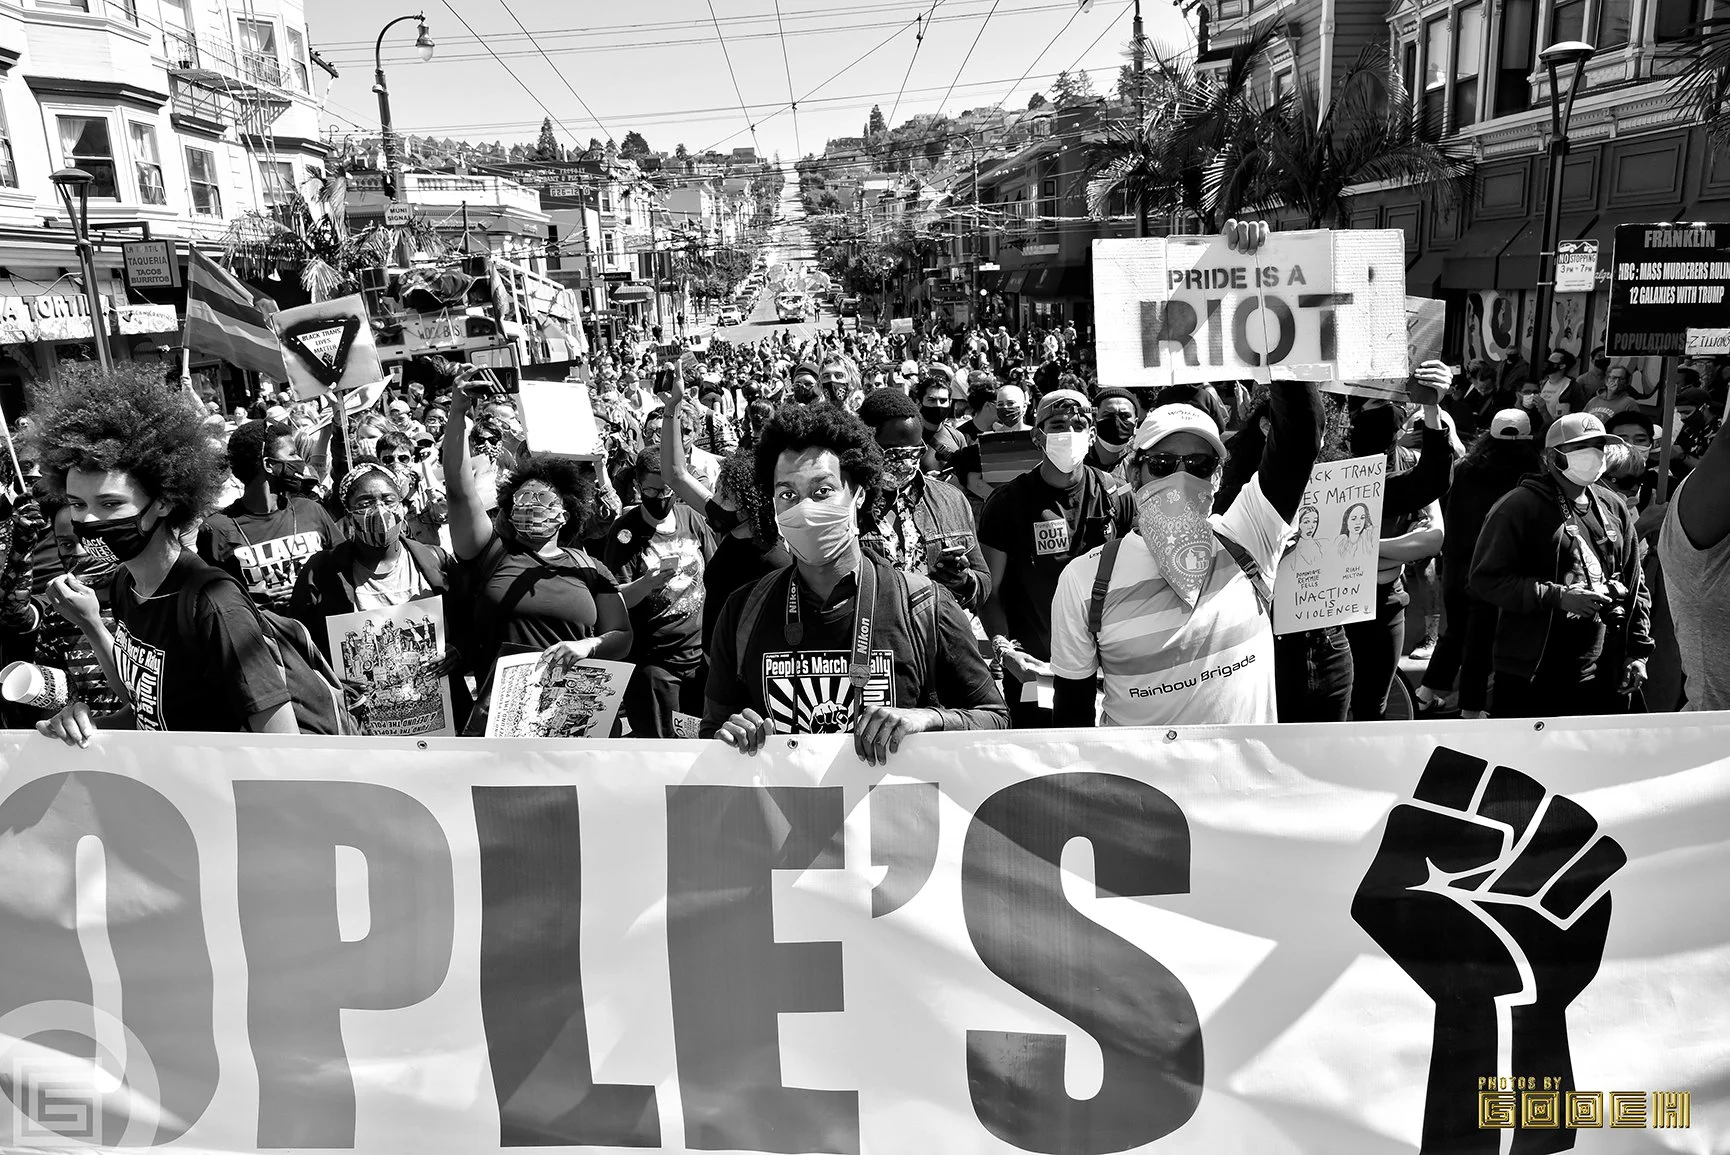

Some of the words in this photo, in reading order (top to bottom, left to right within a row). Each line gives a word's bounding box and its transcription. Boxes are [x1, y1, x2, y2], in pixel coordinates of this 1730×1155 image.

[551, 188, 591, 197] 626-120
[1644, 230, 1716, 248] FRANKLIN
[128, 257, 168, 266] TAQUERIA
[1559, 253, 1569, 264] NO
[1570, 254, 1596, 263] STOPPING
[1168, 267, 1248, 291] PRIDE
[1256, 265, 1280, 289] IS
[1286, 264, 1308, 287] A
[1640, 262, 1662, 281] MASS
[1663, 261, 1709, 280] MURDERERS
[1629, 286, 1639, 304] 12
[1640, 286, 1676, 304] GALAXIES
[1676, 285, 1697, 304] WITH
[1698, 285, 1725, 304] TRUMP
[301, 333, 321, 342] BLACK
[321, 328, 341, 338] TRANS
[1140, 292, 1354, 369] RIOT
[315, 338, 332, 346] LIVES
[1613, 333, 1686, 351] POPULATIONS
[1341, 462, 1384, 481] TRANS
[1325, 481, 1381, 505] MATTER
[1039, 527, 1064, 540] OUT
[233, 531, 323, 568] BLACK
[1037, 537, 1068, 551] NOW
[1342, 571, 1364, 580] MILTON
[1294, 584, 1361, 606] INACTION
[1301, 582, 1319, 590] FELLS
[1295, 603, 1360, 620] VIOLENCE
[1324, 599, 1336, 609] IS
[856, 617, 870, 655] Nikon
[765, 653, 809, 678] People's
[811, 655, 848, 674] March
[870, 655, 891, 677] ally
[1129, 677, 1198, 699] Rainbow
[1200, 653, 1257, 682] Brigade
[140, 671, 157, 715] Unite
[862, 679, 891, 707] Uni
[403, 715, 429, 727] DEFUND
